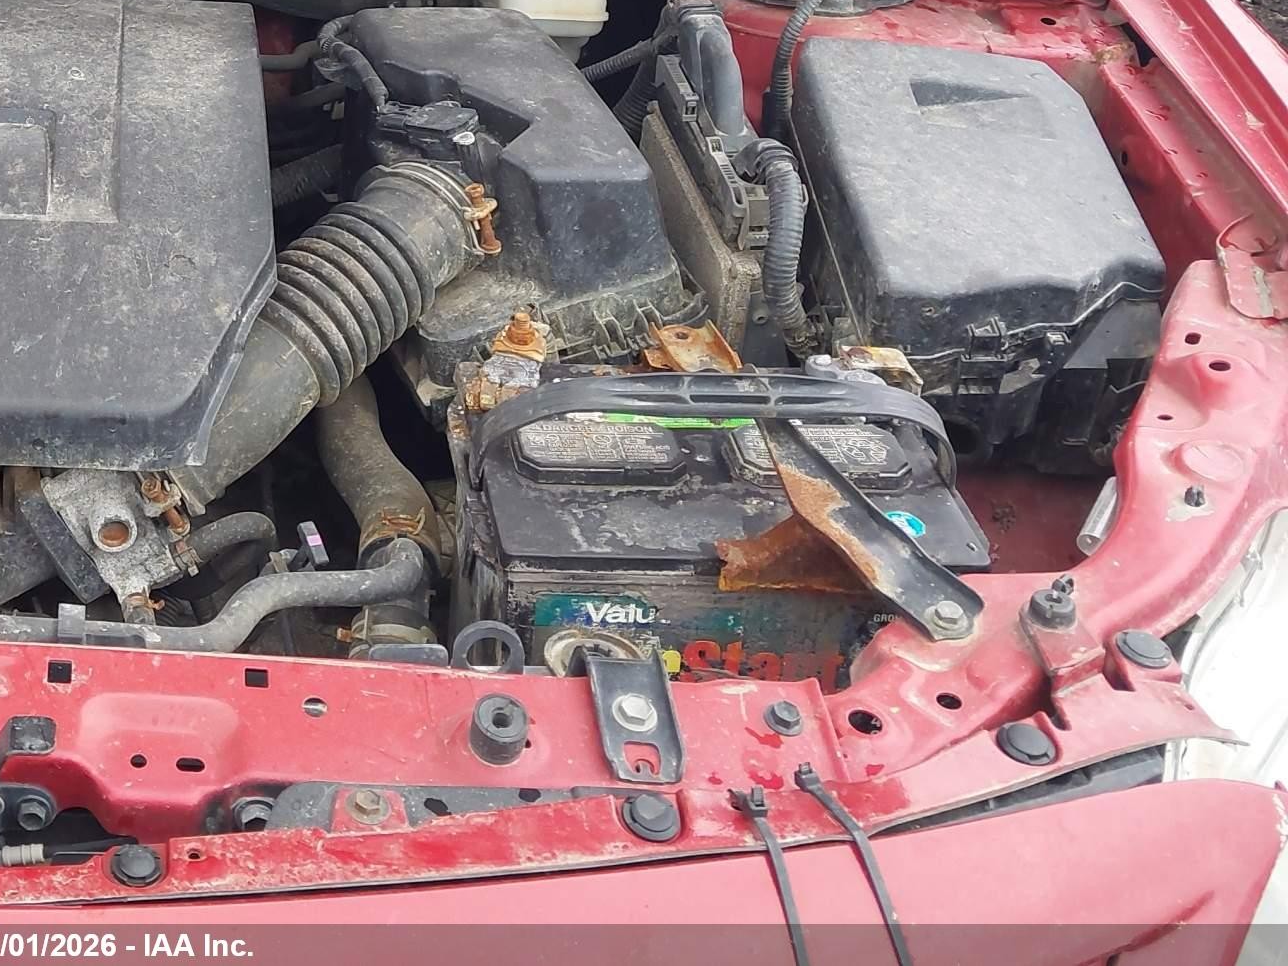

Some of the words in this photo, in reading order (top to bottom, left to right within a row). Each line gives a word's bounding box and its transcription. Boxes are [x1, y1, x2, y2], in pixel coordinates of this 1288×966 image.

[542, 424, 593, 433] DANGER
[606, 425, 654, 434] POISON
[586, 602, 662, 624] Valu
